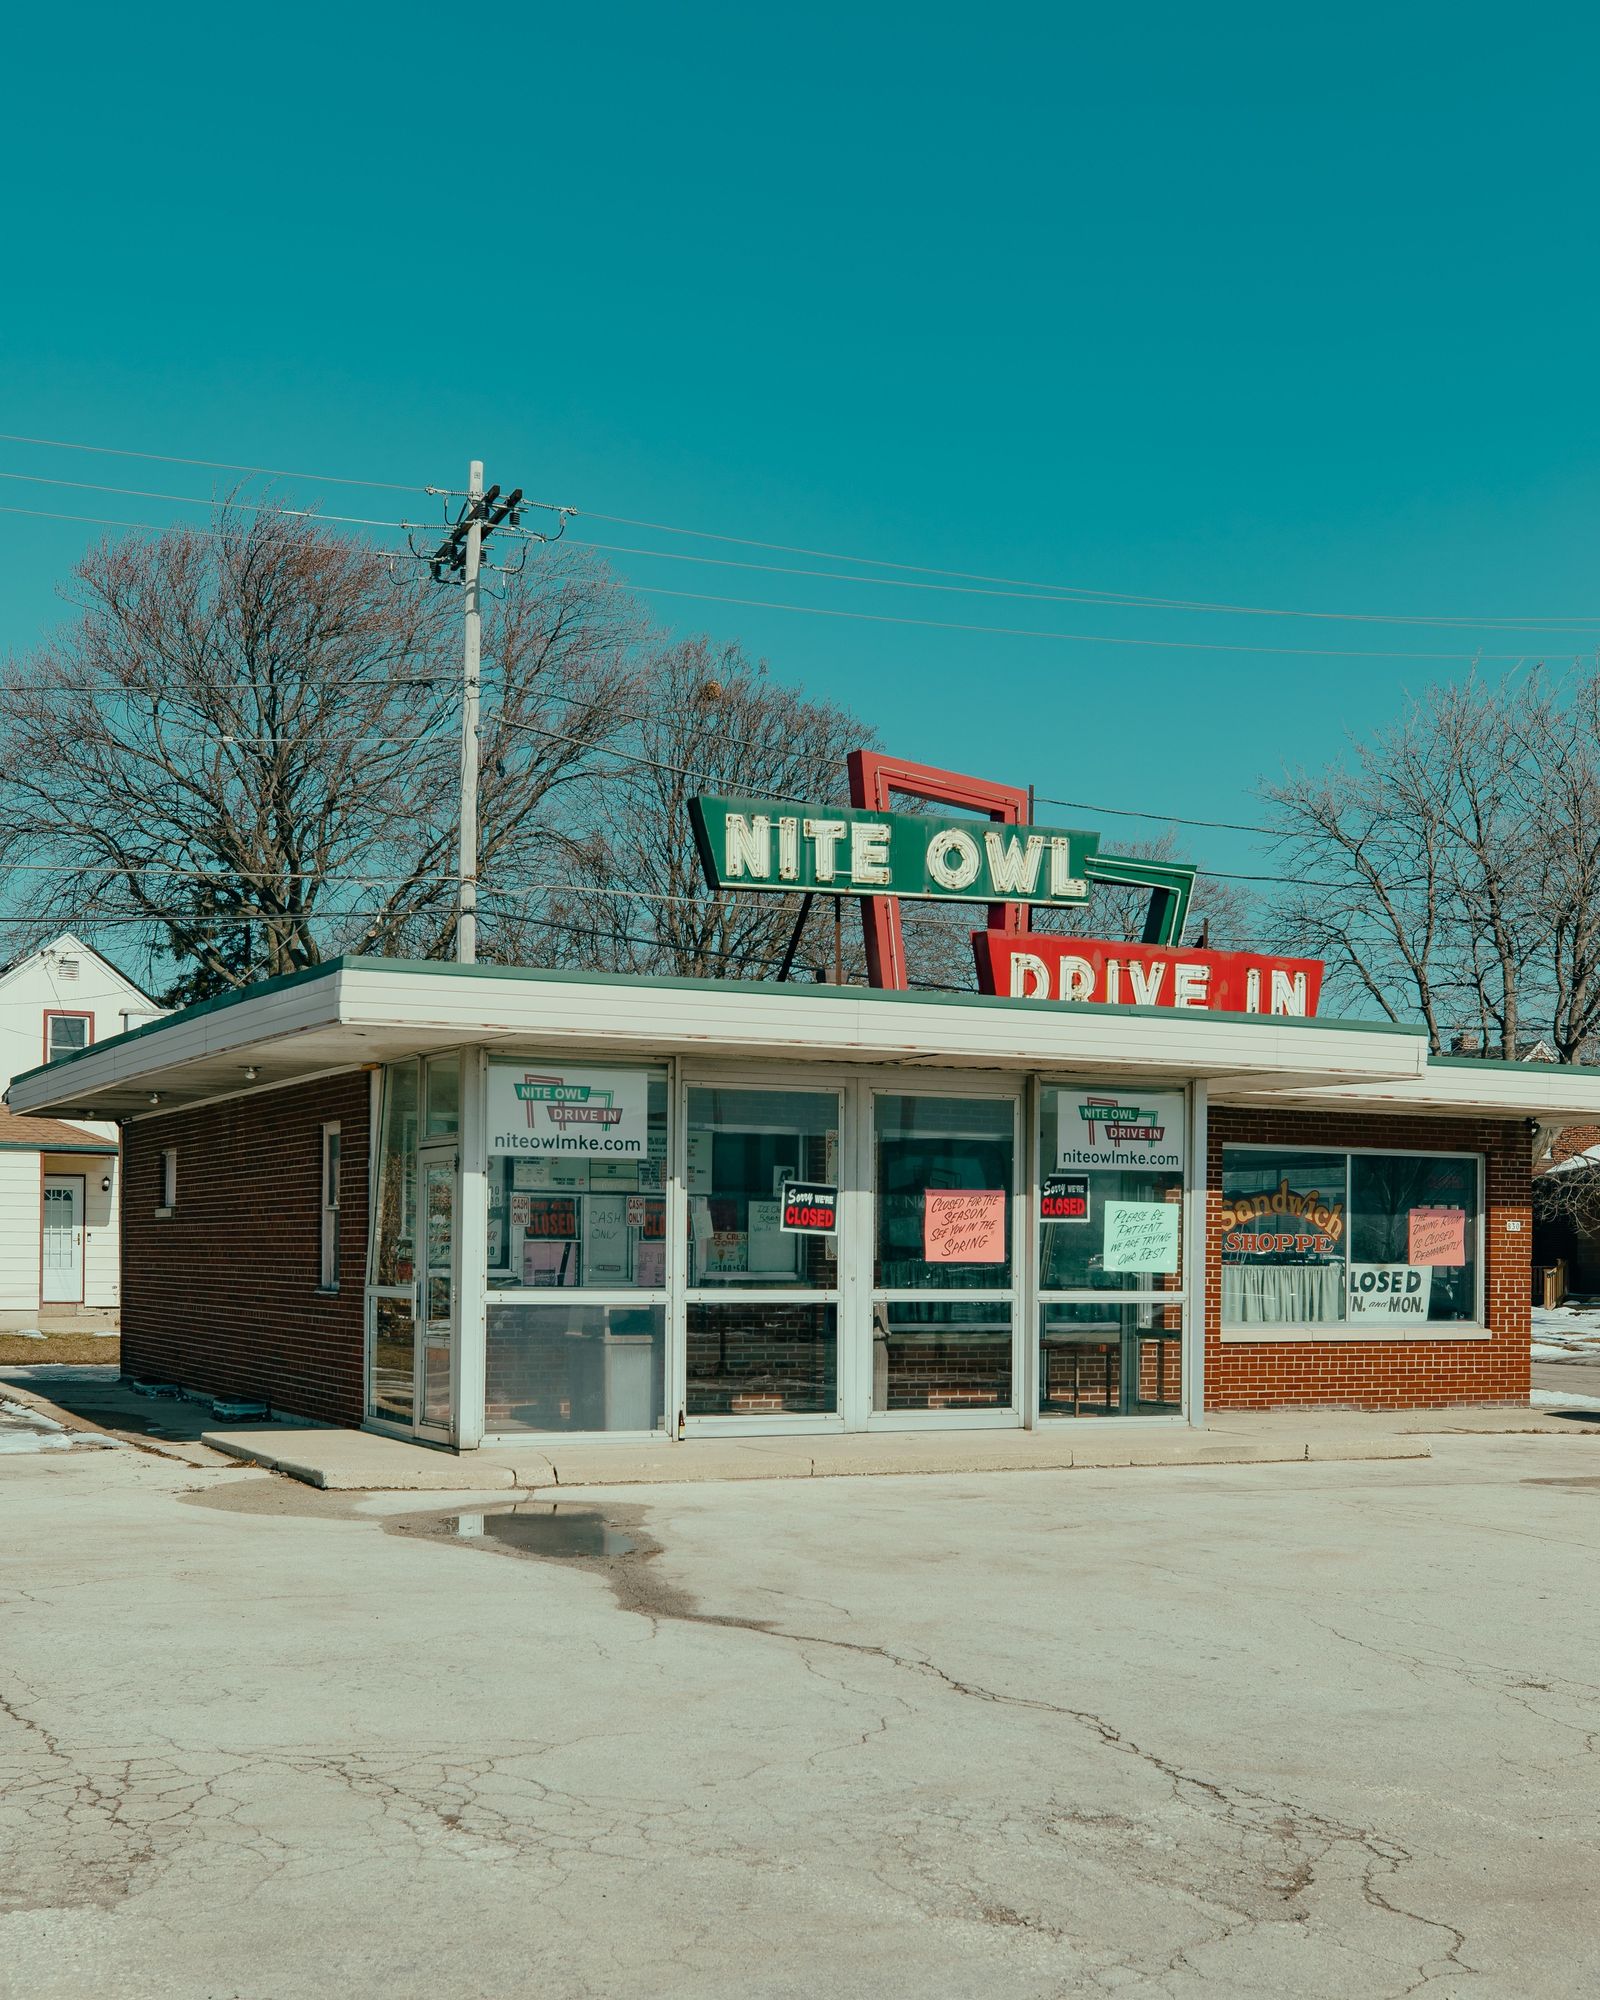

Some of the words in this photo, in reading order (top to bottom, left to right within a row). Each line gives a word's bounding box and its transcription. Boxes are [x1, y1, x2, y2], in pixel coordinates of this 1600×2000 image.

[724, 813, 892, 885] NITE
[926, 827, 1089, 898] OWL
[1008, 952, 1210, 1011] DRIVE
[1245, 967, 1306, 1017] IN
[521, 1086, 551, 1099] NITE
[554, 1088, 585, 1100] OWL
[553, 1110, 598, 1121] DRIVE
[603, 1111, 617, 1122] IN
[1084, 1108, 1108, 1119] NITE
[1111, 1110, 1136, 1120] OWL
[494, 1132, 641, 1151] niteowlmke.com
[1110, 1128, 1145, 1139] DRIVE
[1149, 1128, 1161, 1139] IN
[1063, 1149, 1179, 1165] niteowlmke.com
[787, 1188, 814, 1206] Sorry
[1043, 1181, 1065, 1196] Sorry
[512, 1198, 528, 1210] CASH
[628, 1199, 643, 1210] CASH
[966, 1196, 982, 1207] FOR
[981, 1194, 999, 1206] THE
[1041, 1197, 1086, 1215] CLOSED
[513, 1212, 528, 1224] ONLY
[590, 1210, 621, 1224] CASH
[628, 1212, 643, 1223] ONLY
[785, 1205, 835, 1228] CLOSED
[941, 1207, 988, 1226] SEASON,
[1113, 1209, 1149, 1224] PLEASE
[1151, 1208, 1166, 1221] BE
[1221, 1178, 1344, 1242] Sandwich
[1414, 1213, 1428, 1223] THE
[527, 1213, 575, 1235] CLOSED
[930, 1227, 948, 1241] SEE
[949, 1224, 965, 1237] YOU
[966, 1222, 978, 1232] IN
[979, 1220, 997, 1231] THE
[1116, 1222, 1163, 1238] PATIENT
[1412, 1219, 1439, 1235] DINING
[1440, 1215, 1462, 1228] ROOM
[591, 1228, 618, 1240] ONLY
[1110, 1242, 1122, 1252] WE
[1123, 1238, 1140, 1249] ARE
[1142, 1232, 1172, 1246] TRYING
[1224, 1232, 1334, 1253] SHOPPE
[1413, 1238, 1423, 1249] IS
[1424, 1230, 1455, 1247] CLOSED
[1117, 1252, 1137, 1266] OUR
[1139, 1247, 1167, 1261] BEST
[1413, 1239, 1462, 1263] PERMANENTLY
[1350, 1270, 1421, 1293] LOSED
[1368, 1300, 1389, 1308] and
[1388, 1296, 1424, 1313] MON.
